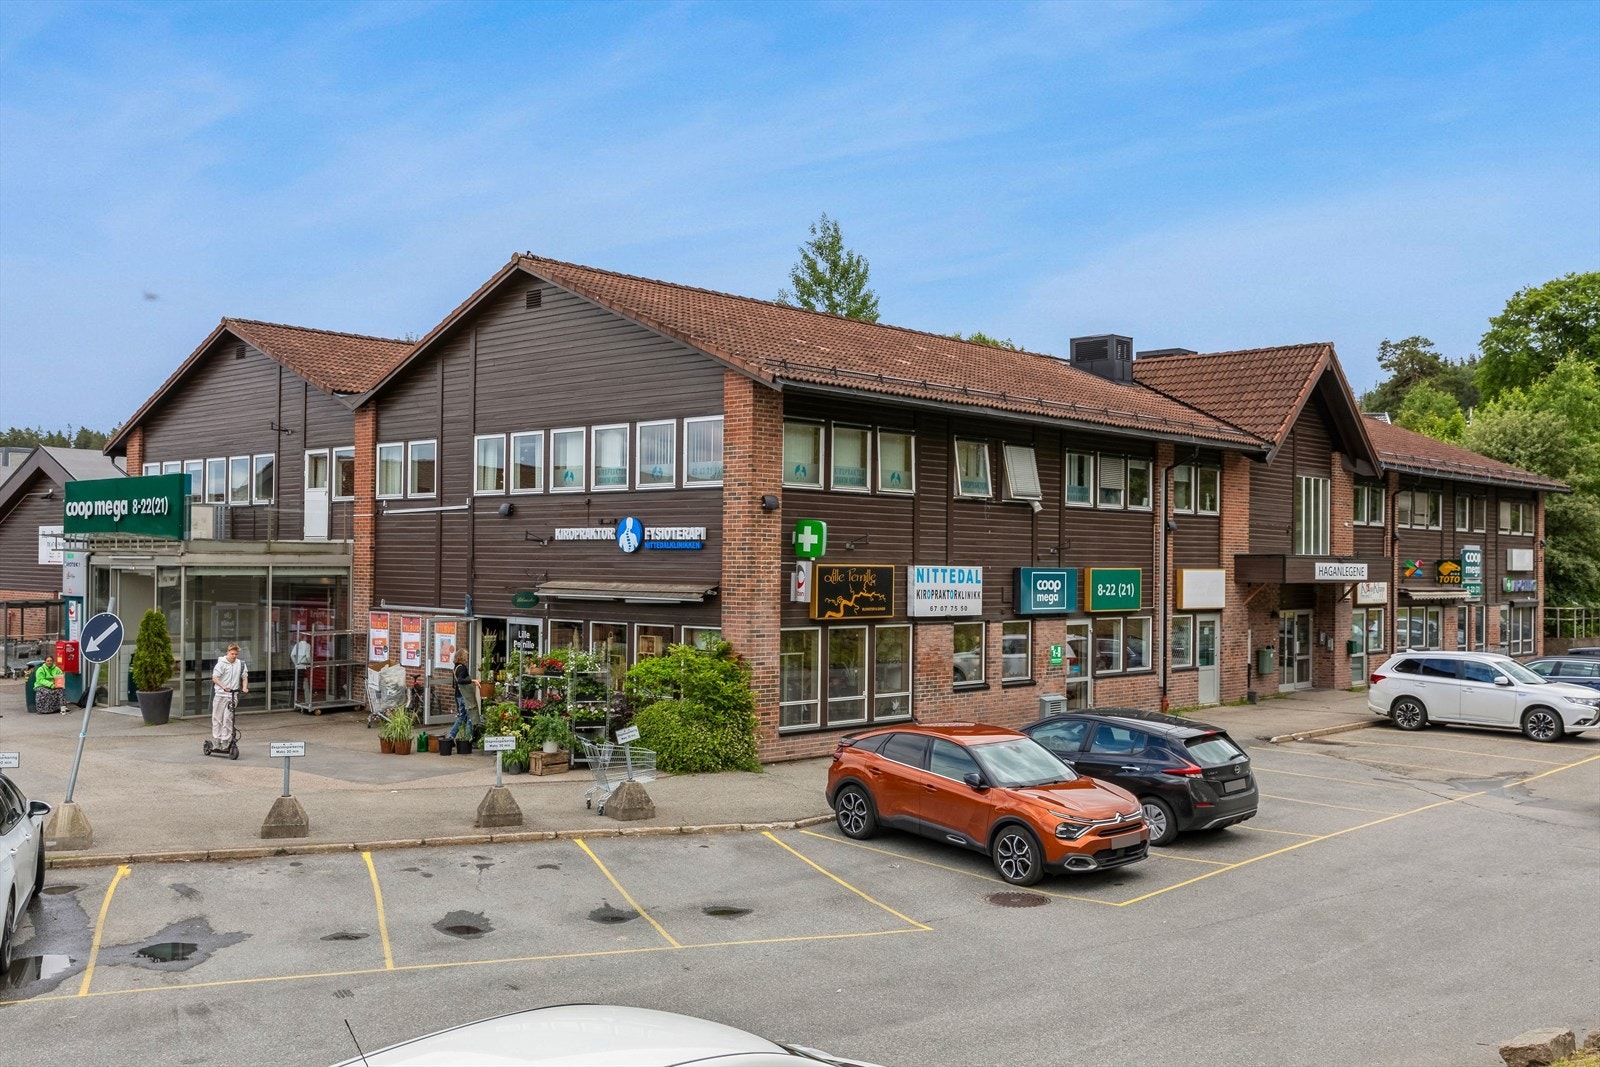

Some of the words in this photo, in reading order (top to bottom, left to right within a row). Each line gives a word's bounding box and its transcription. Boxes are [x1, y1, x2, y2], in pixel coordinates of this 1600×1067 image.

[66, 501, 93, 519] coop
[94, 499, 128, 522] mega
[555, 527, 616, 540] KIROPRAKTOR
[644, 527, 707, 540] FYSIOTERAPI
[916, 568, 981, 584] NITTEDAL
[1318, 566, 1365, 577] HAGANLEGENE
[1440, 575, 1461, 584] TOTO
[1036, 580, 1062, 592] coop
[1097, 583, 1116, 597] 8-22
[1118, 583, 1135, 598] (21)
[916, 589, 981, 600] KIROPRAKTORKLINIKK
[1036, 593, 1059, 605] mega
[518, 630, 530, 639] Lille
